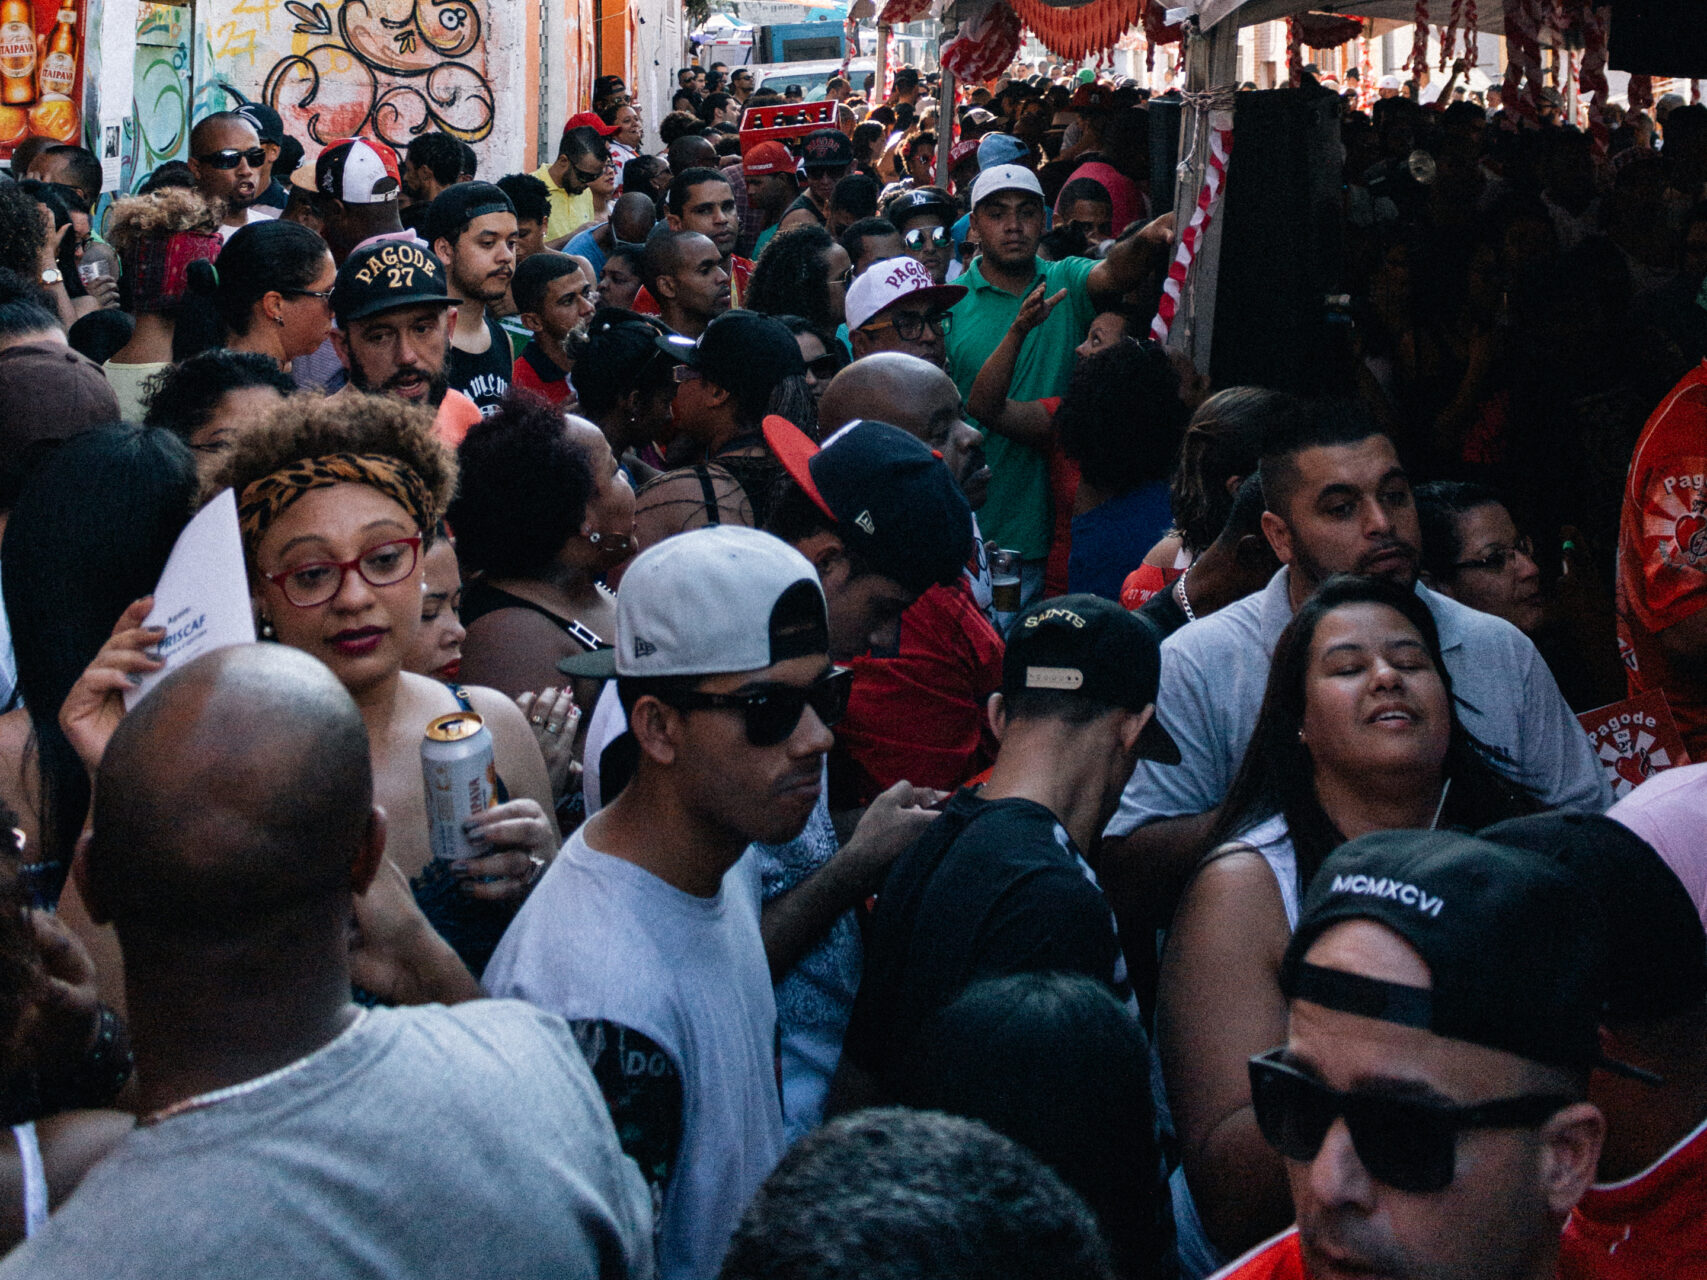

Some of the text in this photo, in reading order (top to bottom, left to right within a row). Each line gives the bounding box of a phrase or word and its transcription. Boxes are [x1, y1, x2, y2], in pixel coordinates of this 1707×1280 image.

[216, 20, 258, 66] 27
[912, 193, 926, 206] LA
[355, 245, 437, 286] PAGODE
[387, 267, 415, 289] 27
[1663, 474, 1707, 496] Pag
[1024, 608, 1087, 629] SAINTS
[1587, 711, 1656, 749] Pagode
[1616, 739, 1636, 754] 27
[1330, 873, 1445, 918] MCMXCVI
